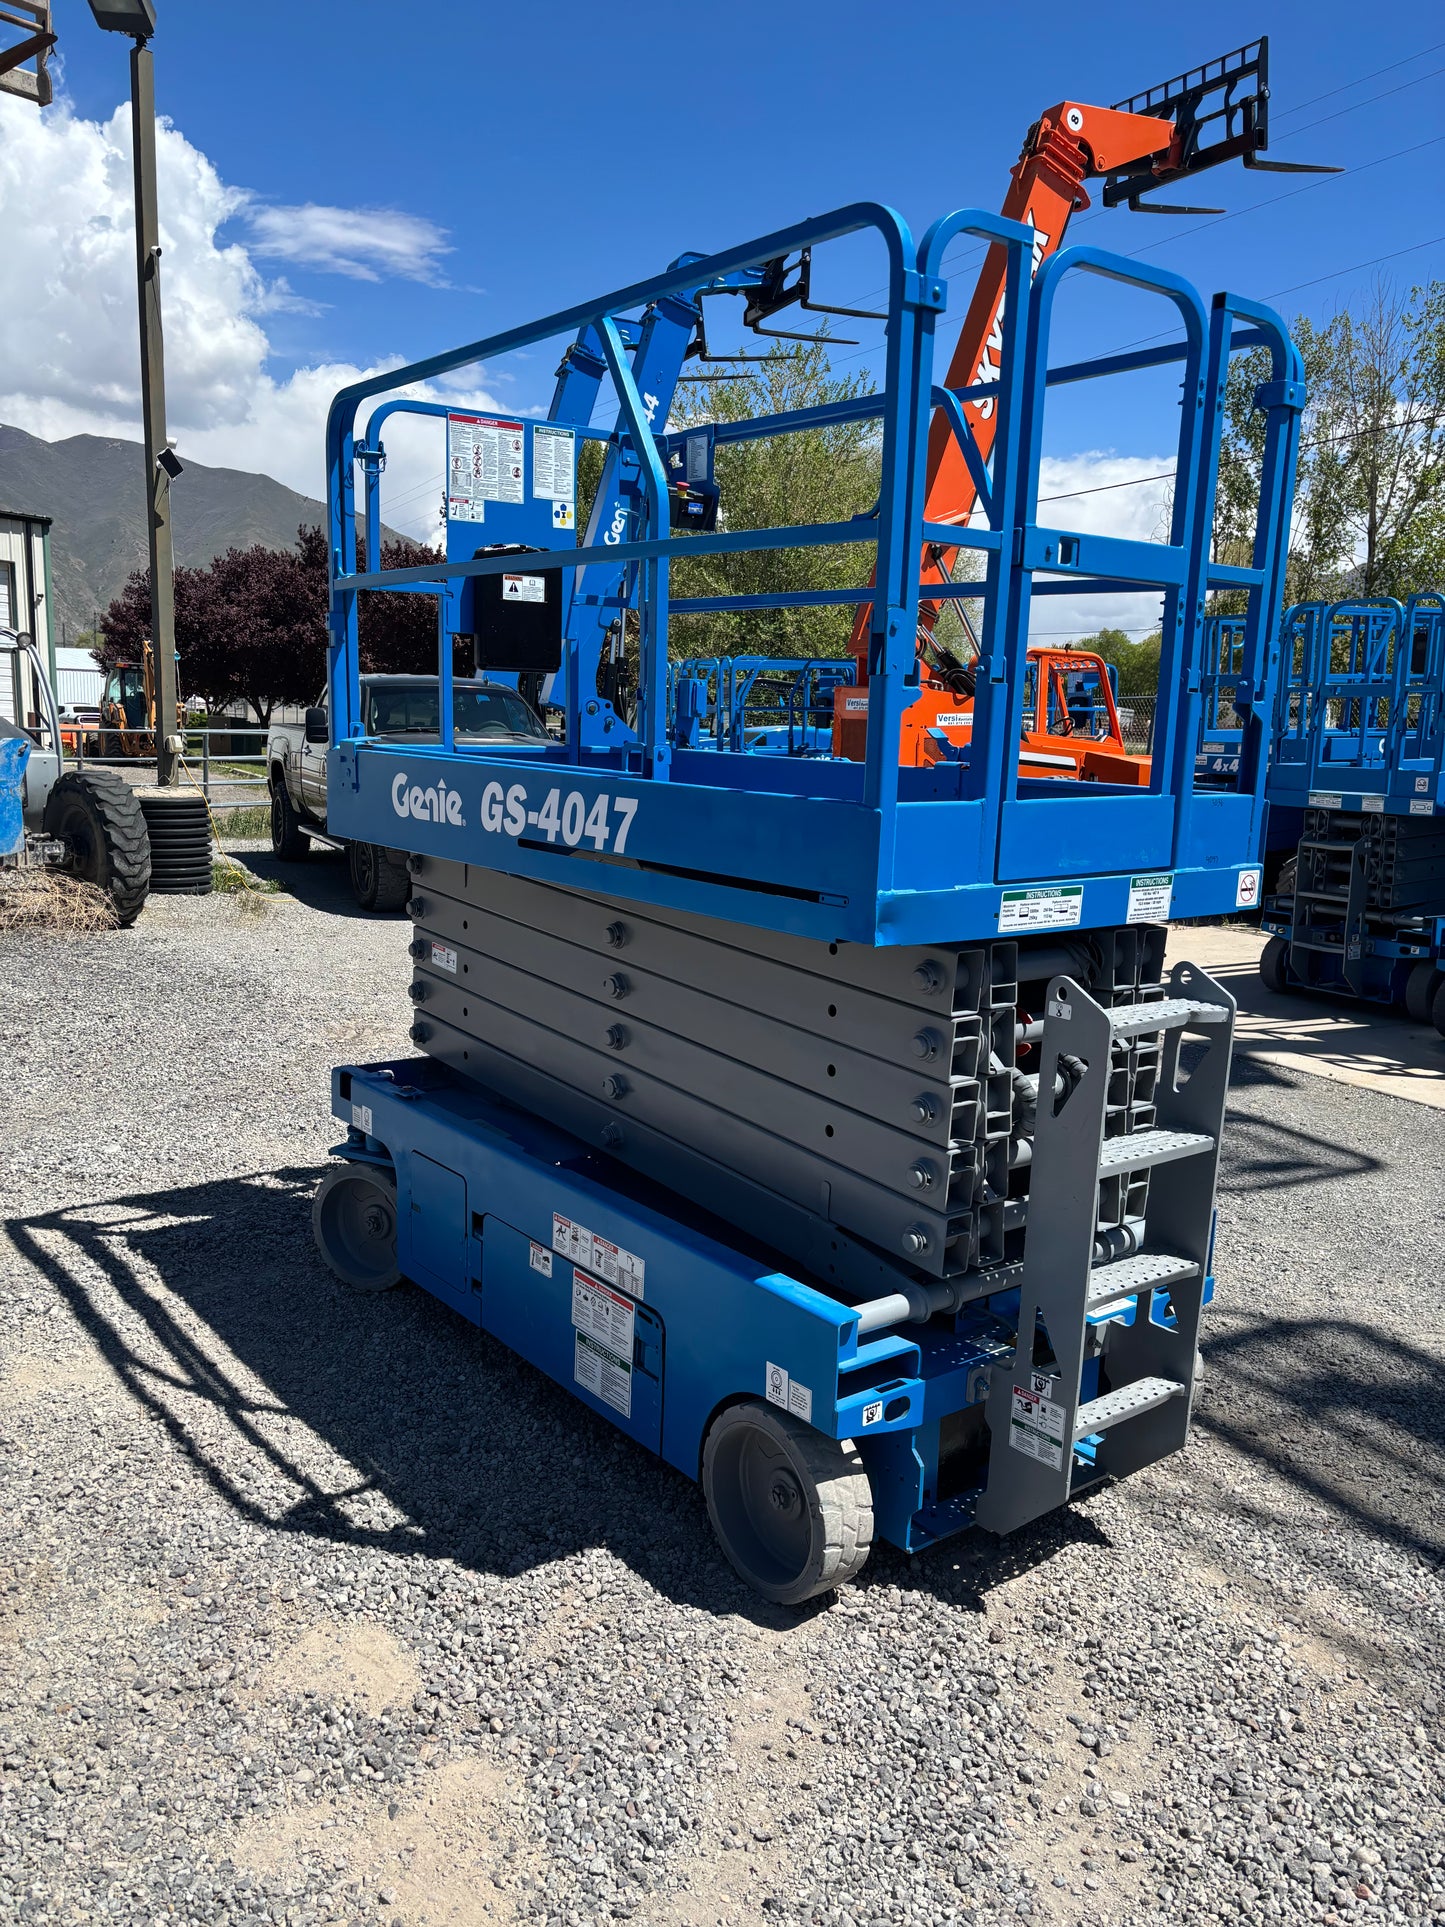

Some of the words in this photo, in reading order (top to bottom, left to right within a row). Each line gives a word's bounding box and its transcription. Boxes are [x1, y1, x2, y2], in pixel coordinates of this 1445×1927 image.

[937, 714, 958, 722] Versi
[1212, 758, 1240, 773] 4x4
[391, 773, 463, 827] Genie
[481, 781, 640, 855] GS-4047
[1135, 877, 1170, 887] INSTRUCTIONS
[1025, 889, 1062, 899] INSTRUCTIONS
[585, 1339, 621, 1366] INSTRUCTIONS
[1021, 1391, 1037, 1401] DANGER
